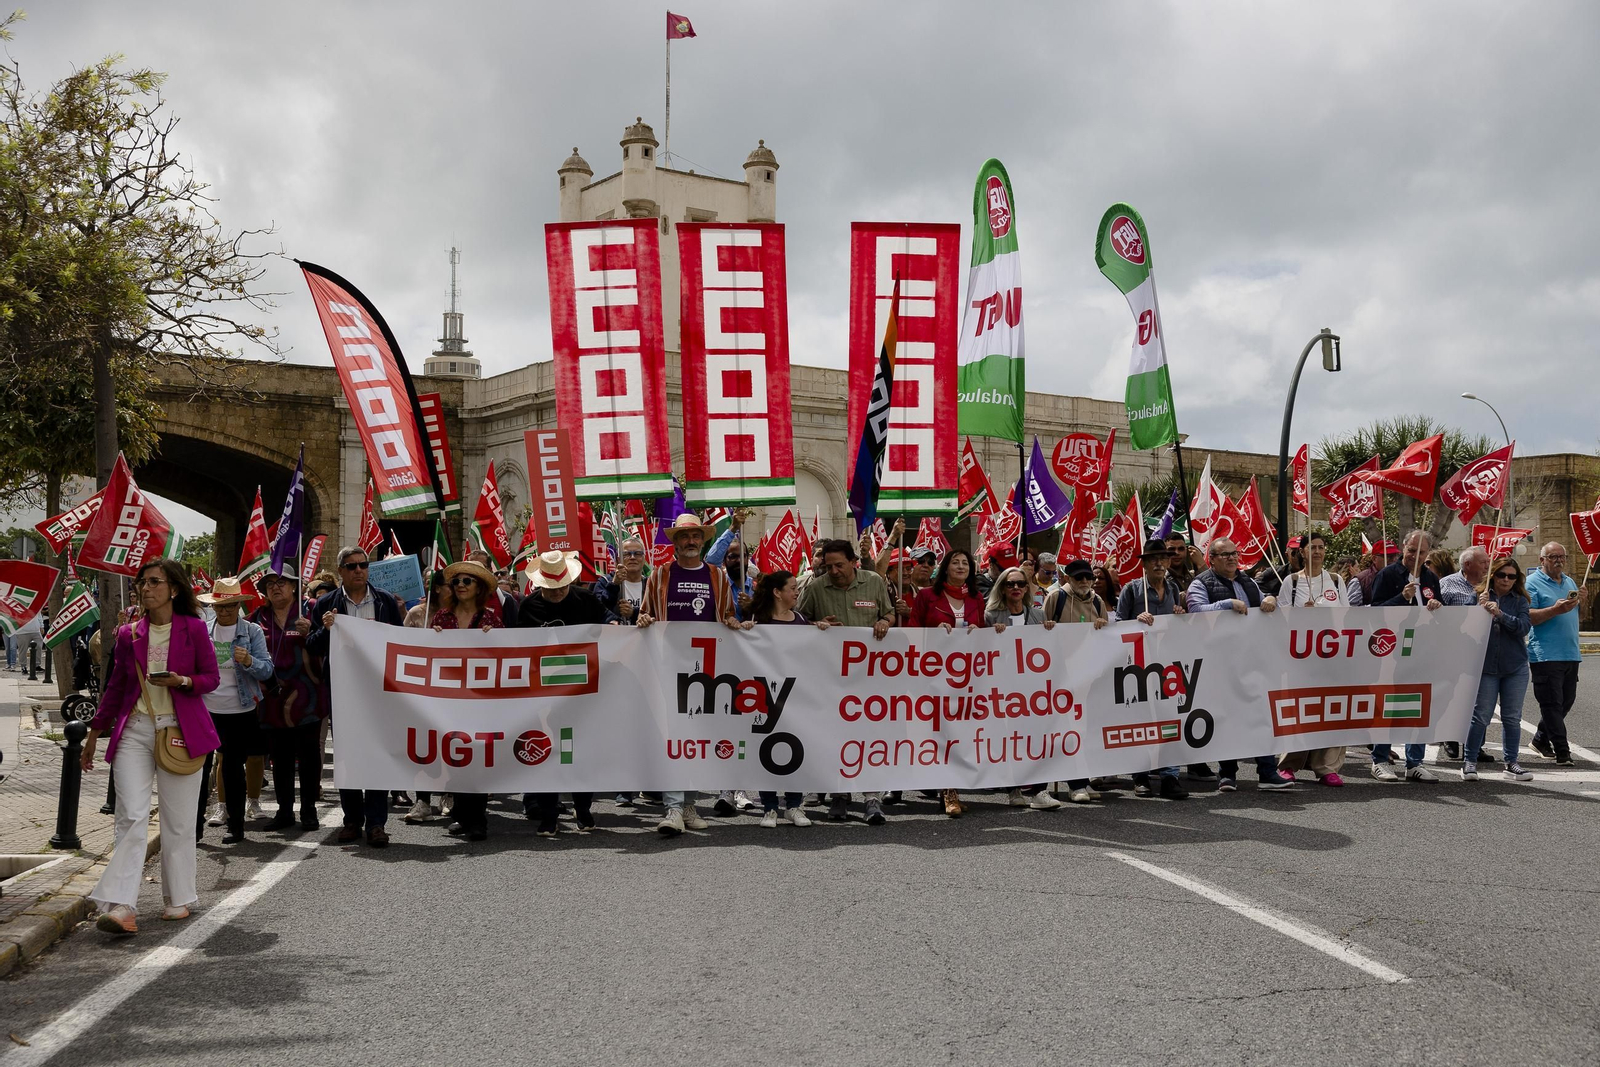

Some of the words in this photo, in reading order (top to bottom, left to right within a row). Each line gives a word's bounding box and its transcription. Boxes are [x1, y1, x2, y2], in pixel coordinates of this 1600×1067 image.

[571, 227, 648, 476] CCOO
[701, 228, 771, 478] CCOO
[1060, 439, 1099, 458] UGT
[538, 433, 566, 522] CCOO
[550, 540, 571, 549] Cádiz
[1290, 629, 1363, 659] UGT
[395, 653, 531, 689] CCOO
[840, 640, 1000, 689] Proteger
[1015, 638, 1051, 675] lo
[838, 679, 1083, 732] conquistado,
[1275, 693, 1376, 727] CCOO
[407, 727, 505, 768] UGT
[667, 739, 712, 759] UGT
[839, 737, 960, 779] ganar
[972, 727, 1081, 764] futuro
[1106, 725, 1159, 745] CCOO
